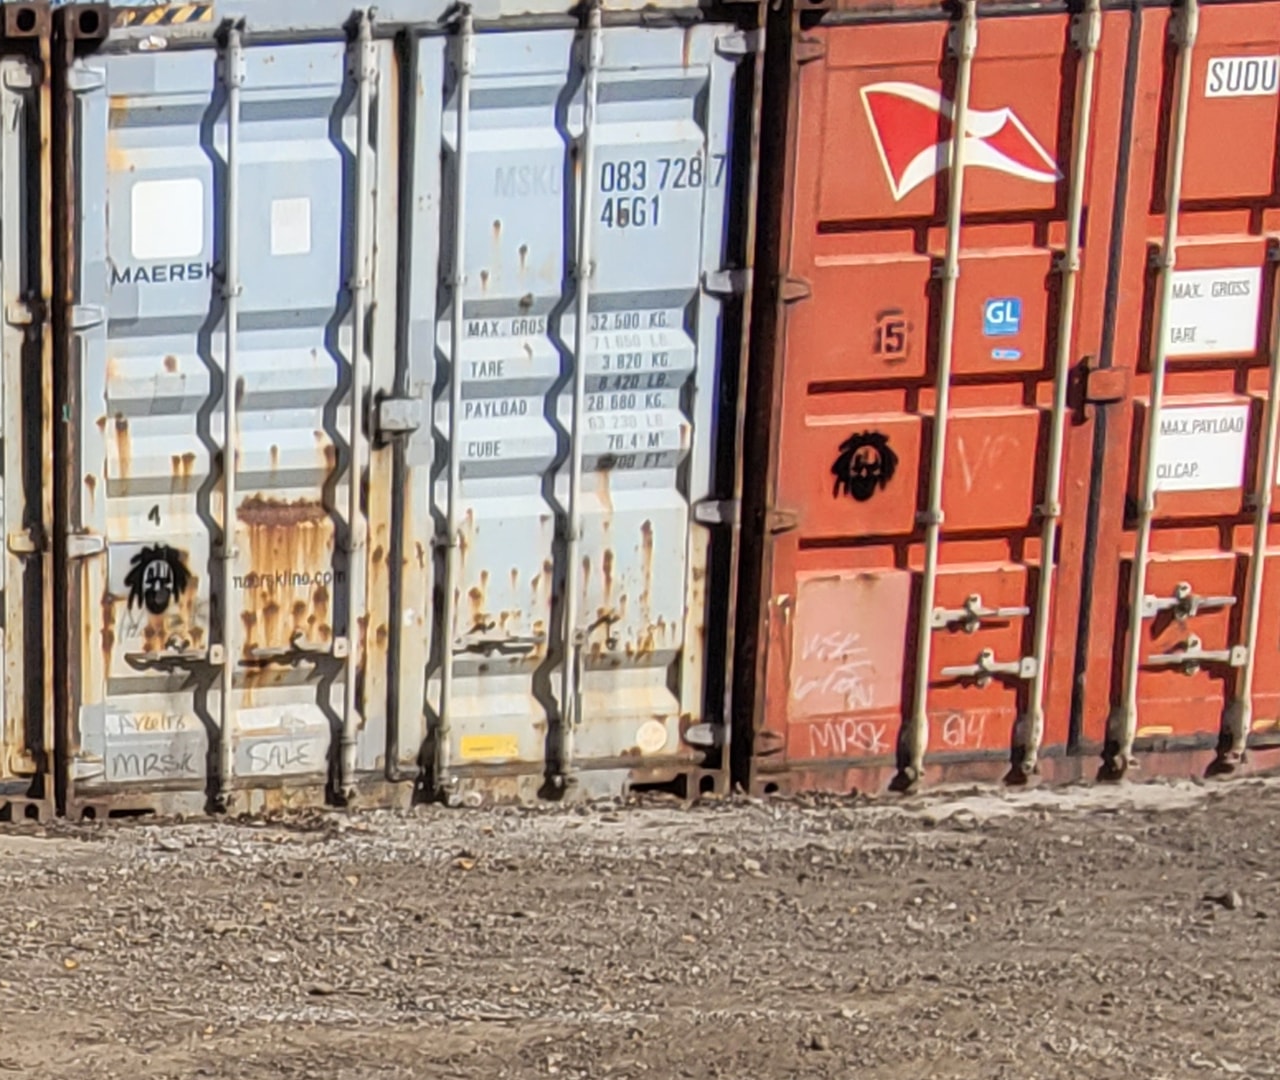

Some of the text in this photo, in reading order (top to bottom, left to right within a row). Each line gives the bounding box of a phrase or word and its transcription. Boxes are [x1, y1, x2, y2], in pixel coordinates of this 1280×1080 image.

[1209, 60, 1277, 92] SUDU
[600, 160, 646, 192] 083
[657, 157, 702, 189] 728
[112, 263, 226, 285] MAERSK
[1211, 280, 1250, 297] GROSS
[986, 301, 1019, 323] GL
[467, 321, 507, 337] MAX.
[471, 360, 504, 378] TARE
[465, 400, 527, 419] PAYLOAD
[1192, 417, 1244, 434] PAYLOAD
[468, 441, 501, 458] CUBE
[246, 741, 313, 772] SALE
